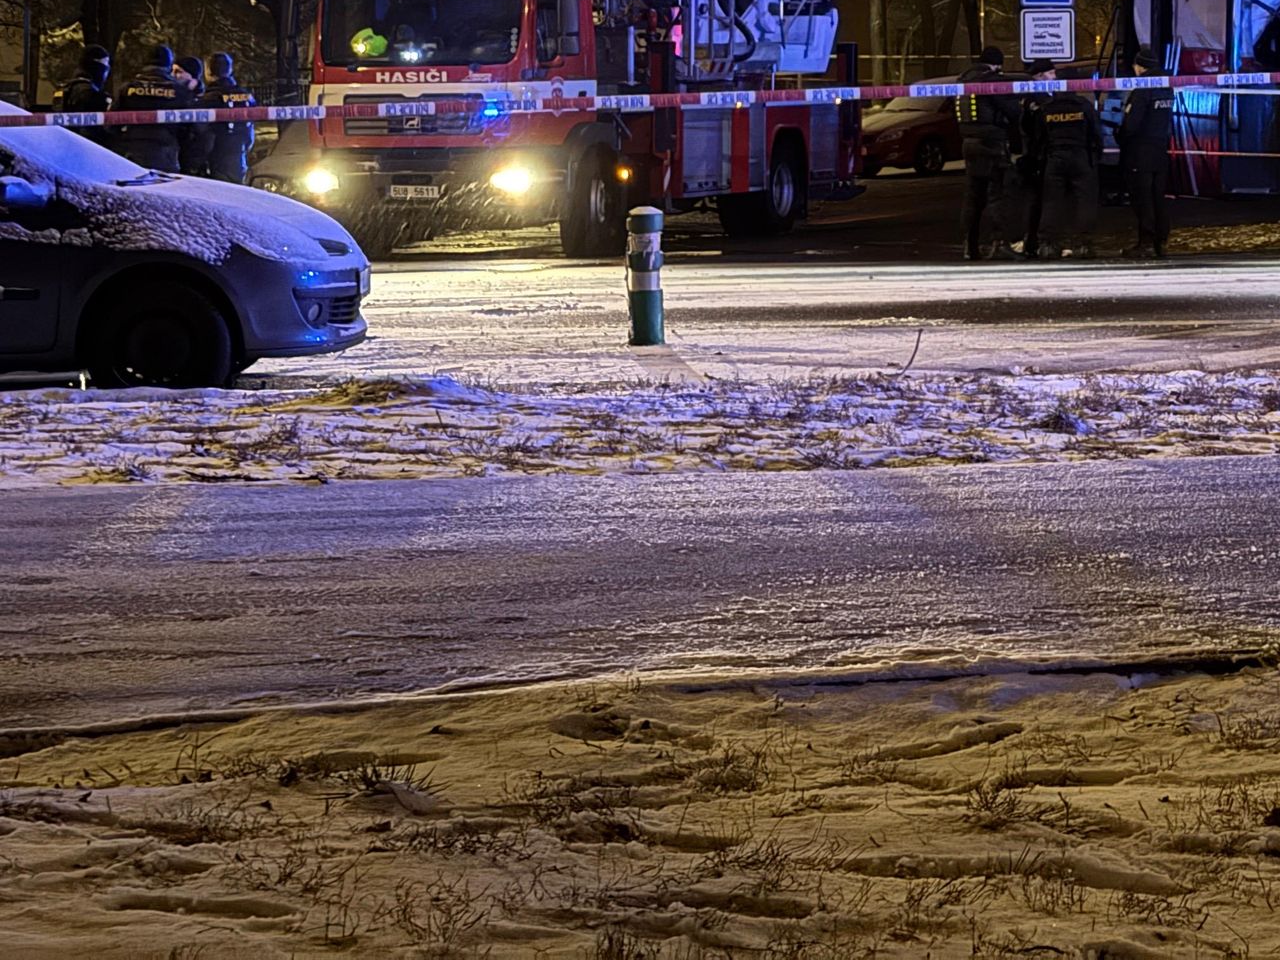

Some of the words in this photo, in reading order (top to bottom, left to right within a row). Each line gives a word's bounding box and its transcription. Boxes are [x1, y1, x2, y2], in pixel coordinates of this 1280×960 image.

[375, 69, 448, 83] HASIČI
[127, 87, 176, 98] POLICIE
[1046, 112, 1085, 123] POLICIE
